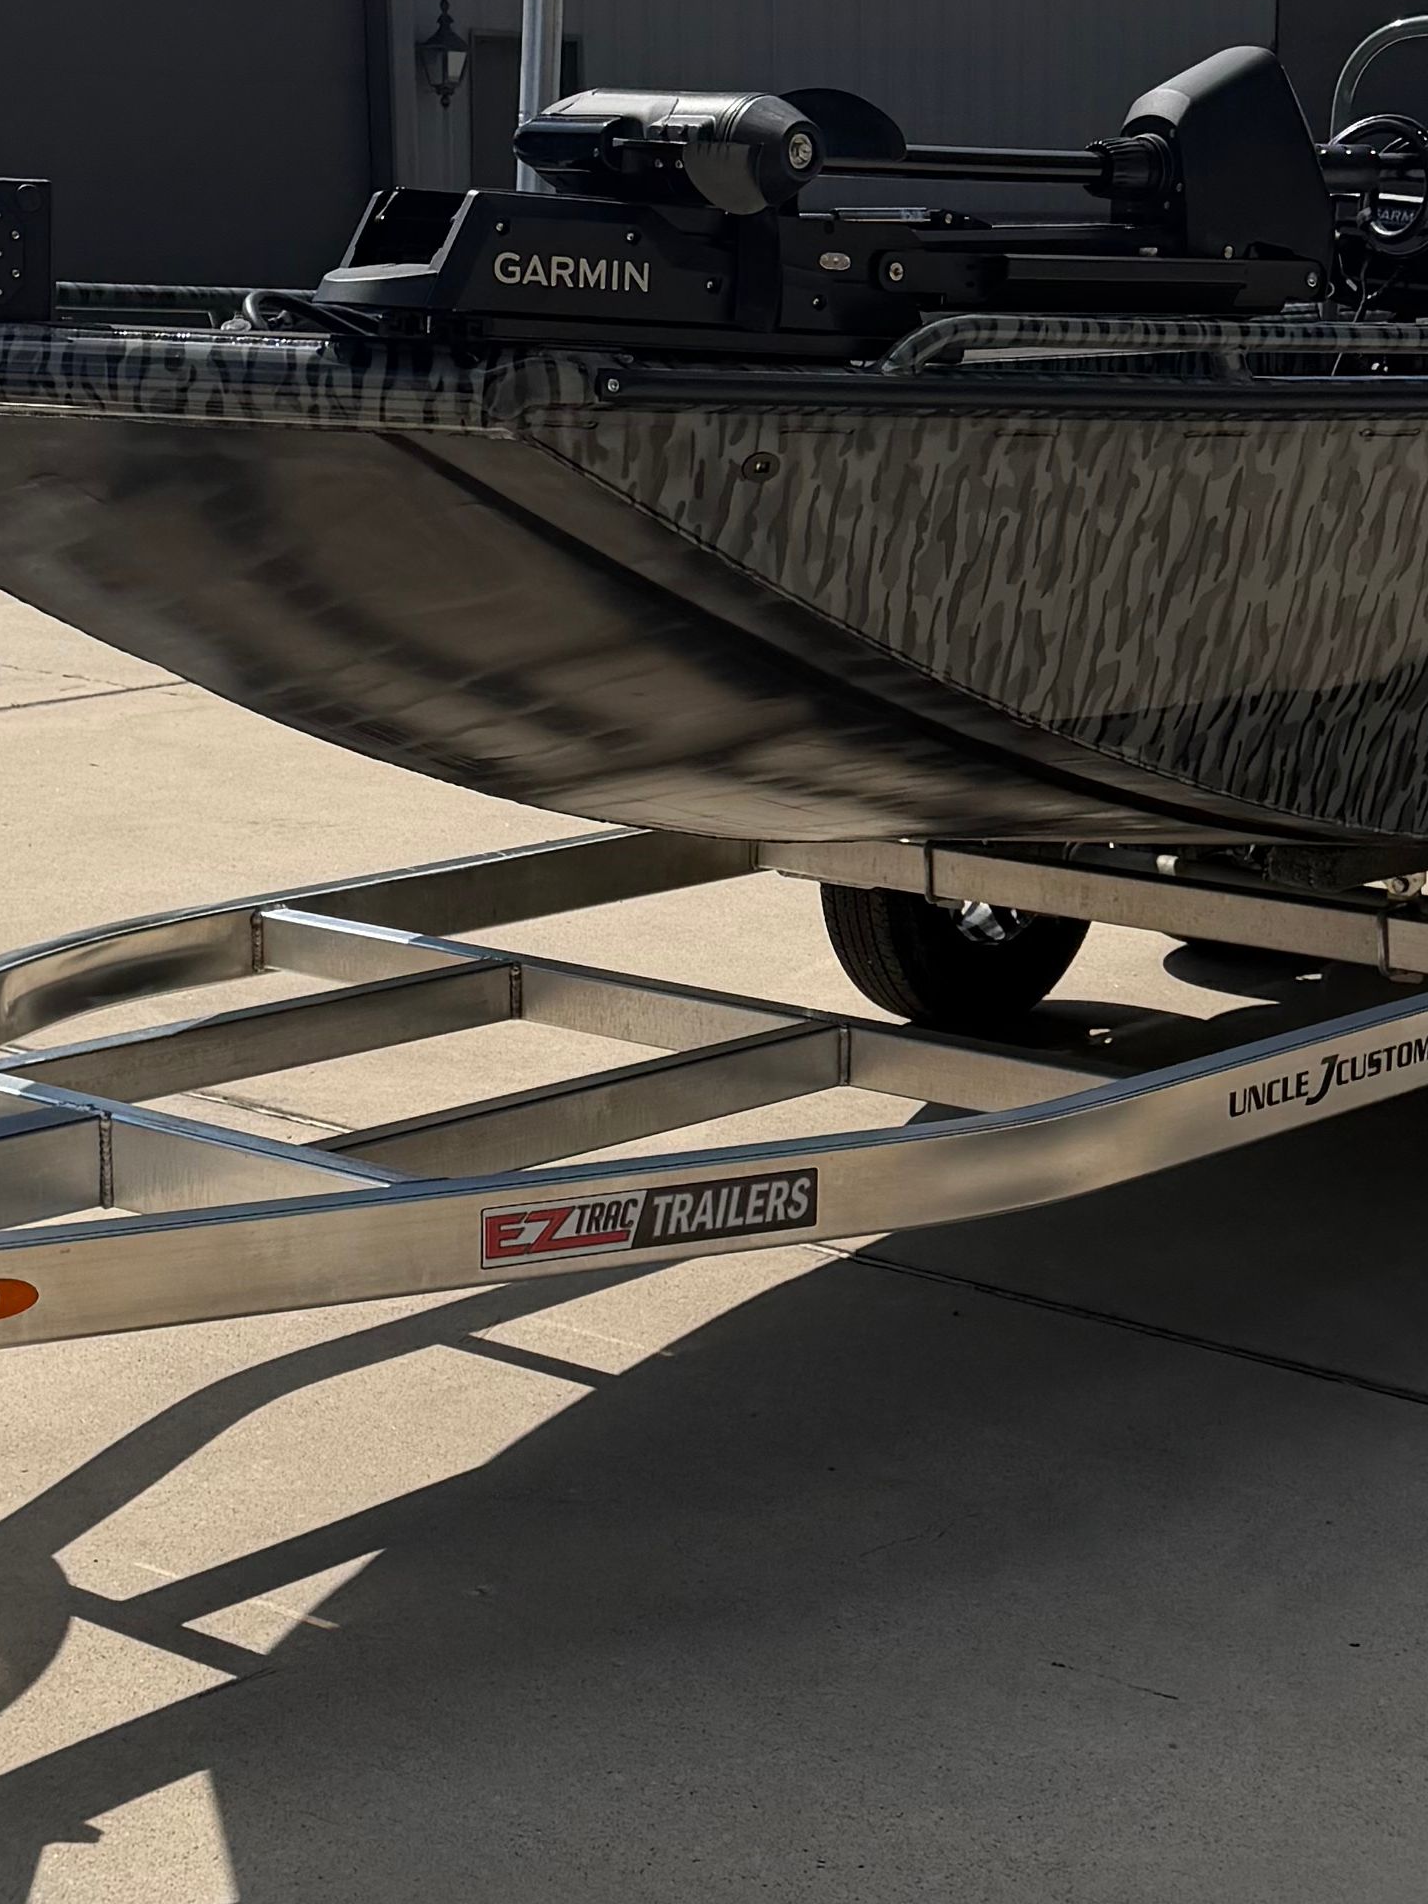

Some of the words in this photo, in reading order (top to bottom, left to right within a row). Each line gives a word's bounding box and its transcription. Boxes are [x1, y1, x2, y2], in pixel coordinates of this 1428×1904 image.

[493, 251, 650, 293] GARMIN
[485, 1206, 632, 1260] EZ
[575, 1198, 639, 1236] TRAC
[653, 1176, 812, 1240] TRAILERS
